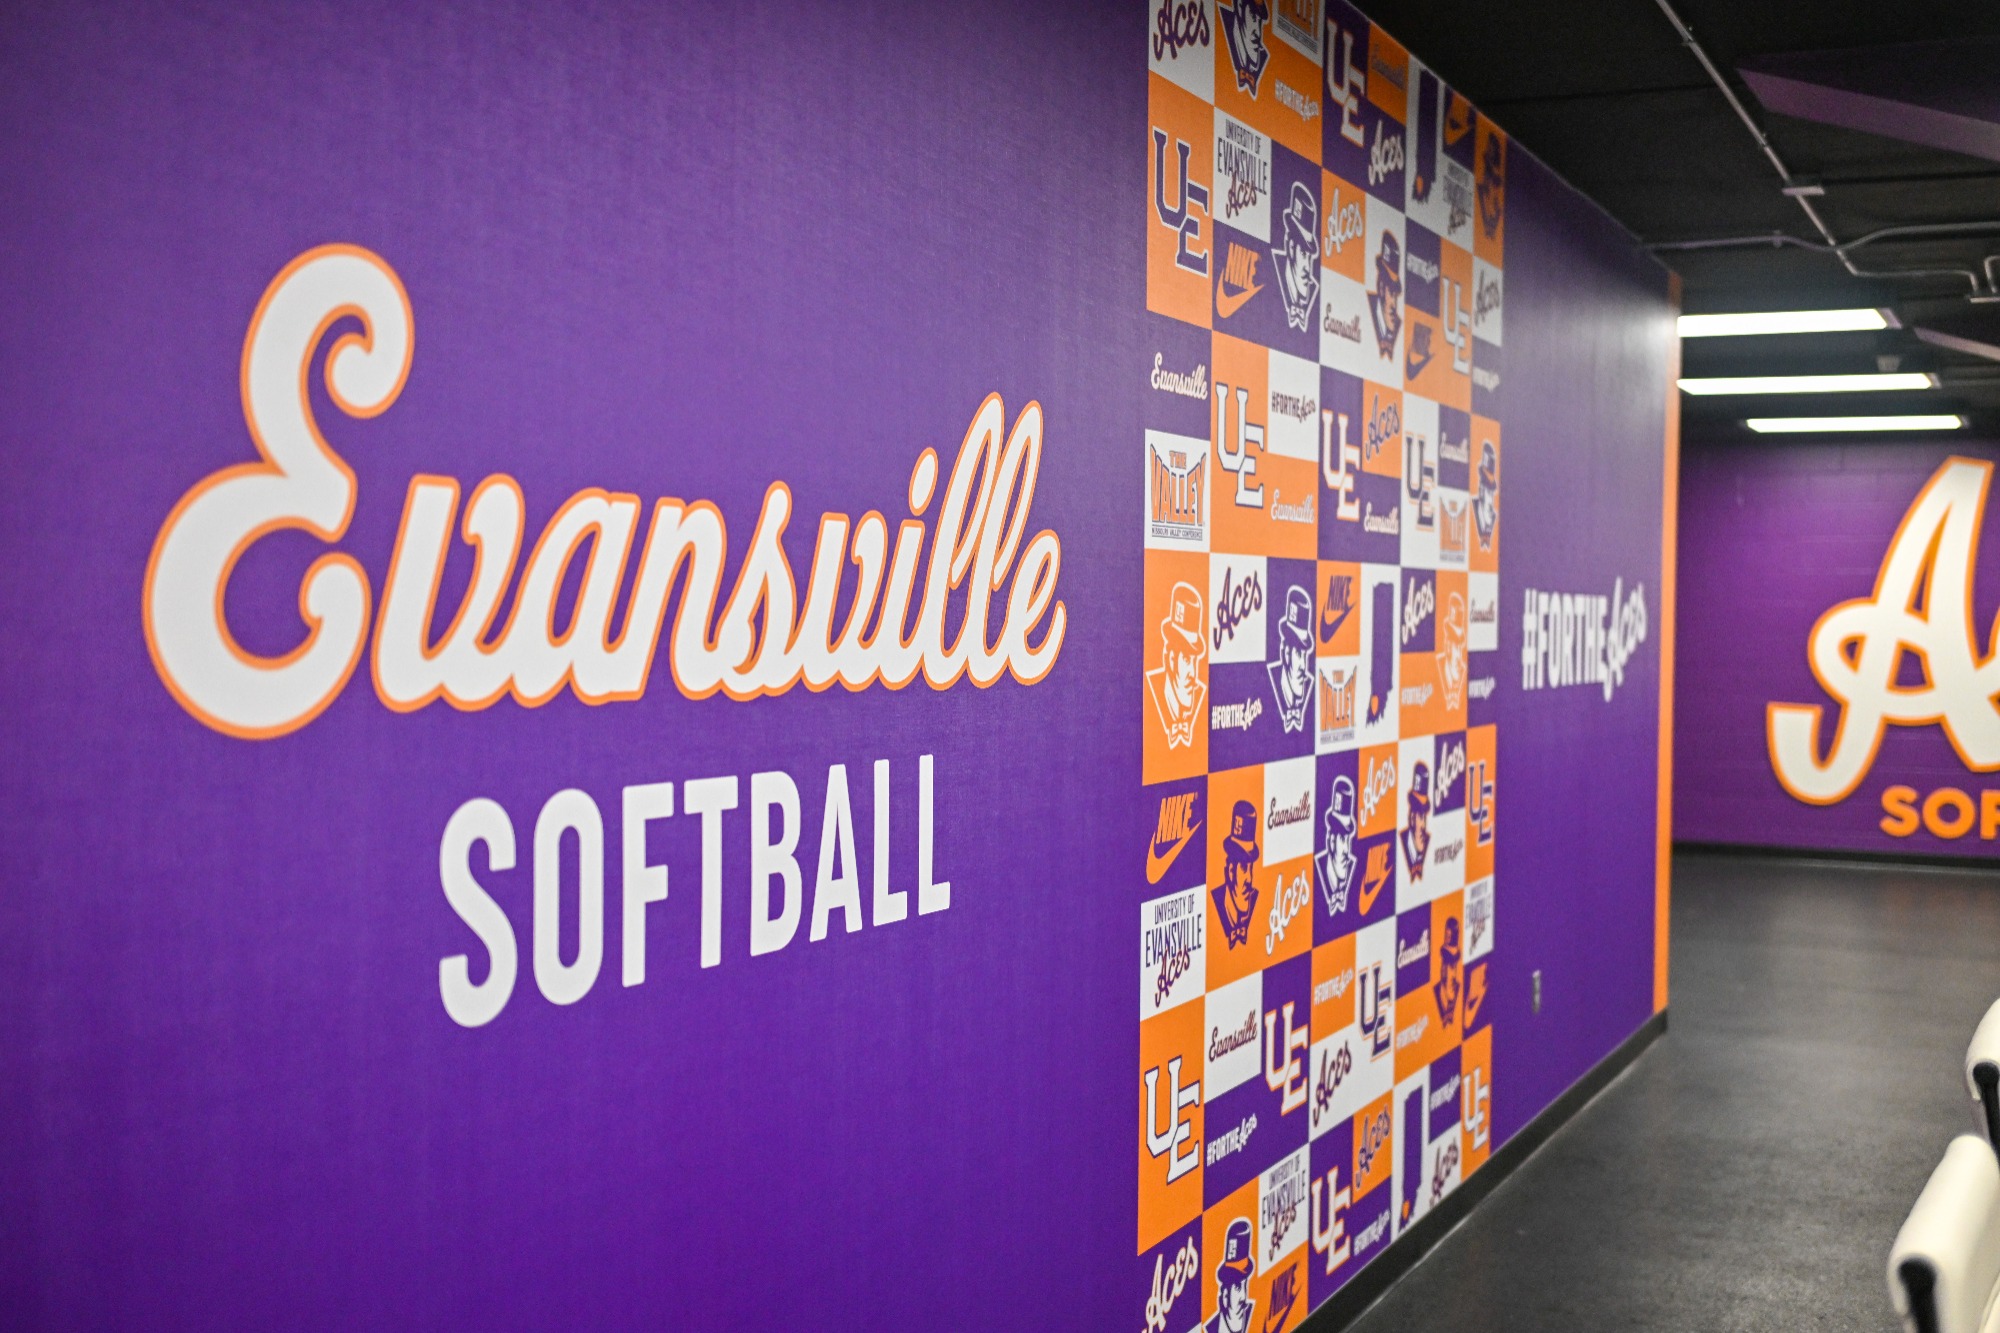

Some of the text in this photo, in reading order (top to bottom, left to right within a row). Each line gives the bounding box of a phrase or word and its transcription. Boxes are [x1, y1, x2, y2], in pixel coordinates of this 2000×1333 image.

[1327, 18, 1365, 148] UE
[1152, 126, 1210, 278] UE
[1217, 136, 1267, 195] EVANSVILLE
[1442, 276, 1472, 376] UE
[1150, 352, 1208, 400] Evansville
[142, 242, 1066, 741] Evansville
[1150, 443, 1206, 526] VALLEY
[1169, 450, 1187, 470] THE
[1215, 381, 1264, 509] UE
[1321, 408, 1361, 523] UE
[1405, 430, 1436, 532] UE
[1156, 792, 1196, 844] NIKE
[1267, 790, 1311, 830] Evansville
[1468, 760, 1495, 847] UE
[438, 753, 951, 1029] SOFTBALL
[1154, 893, 1195, 925] UNIVERSITY OF
[1145, 914, 1202, 968] EVANSVILLE
[1208, 1008, 1258, 1063] Evansville
[1358, 960, 1393, 1063] UE
[1264, 1001, 1308, 1116] UE
[1144, 1054, 1200, 1185] UE
[1463, 1066, 1489, 1152] UE
[1262, 1169, 1306, 1230] EVANSVILLE
[1311, 1165, 1351, 1276] UE
